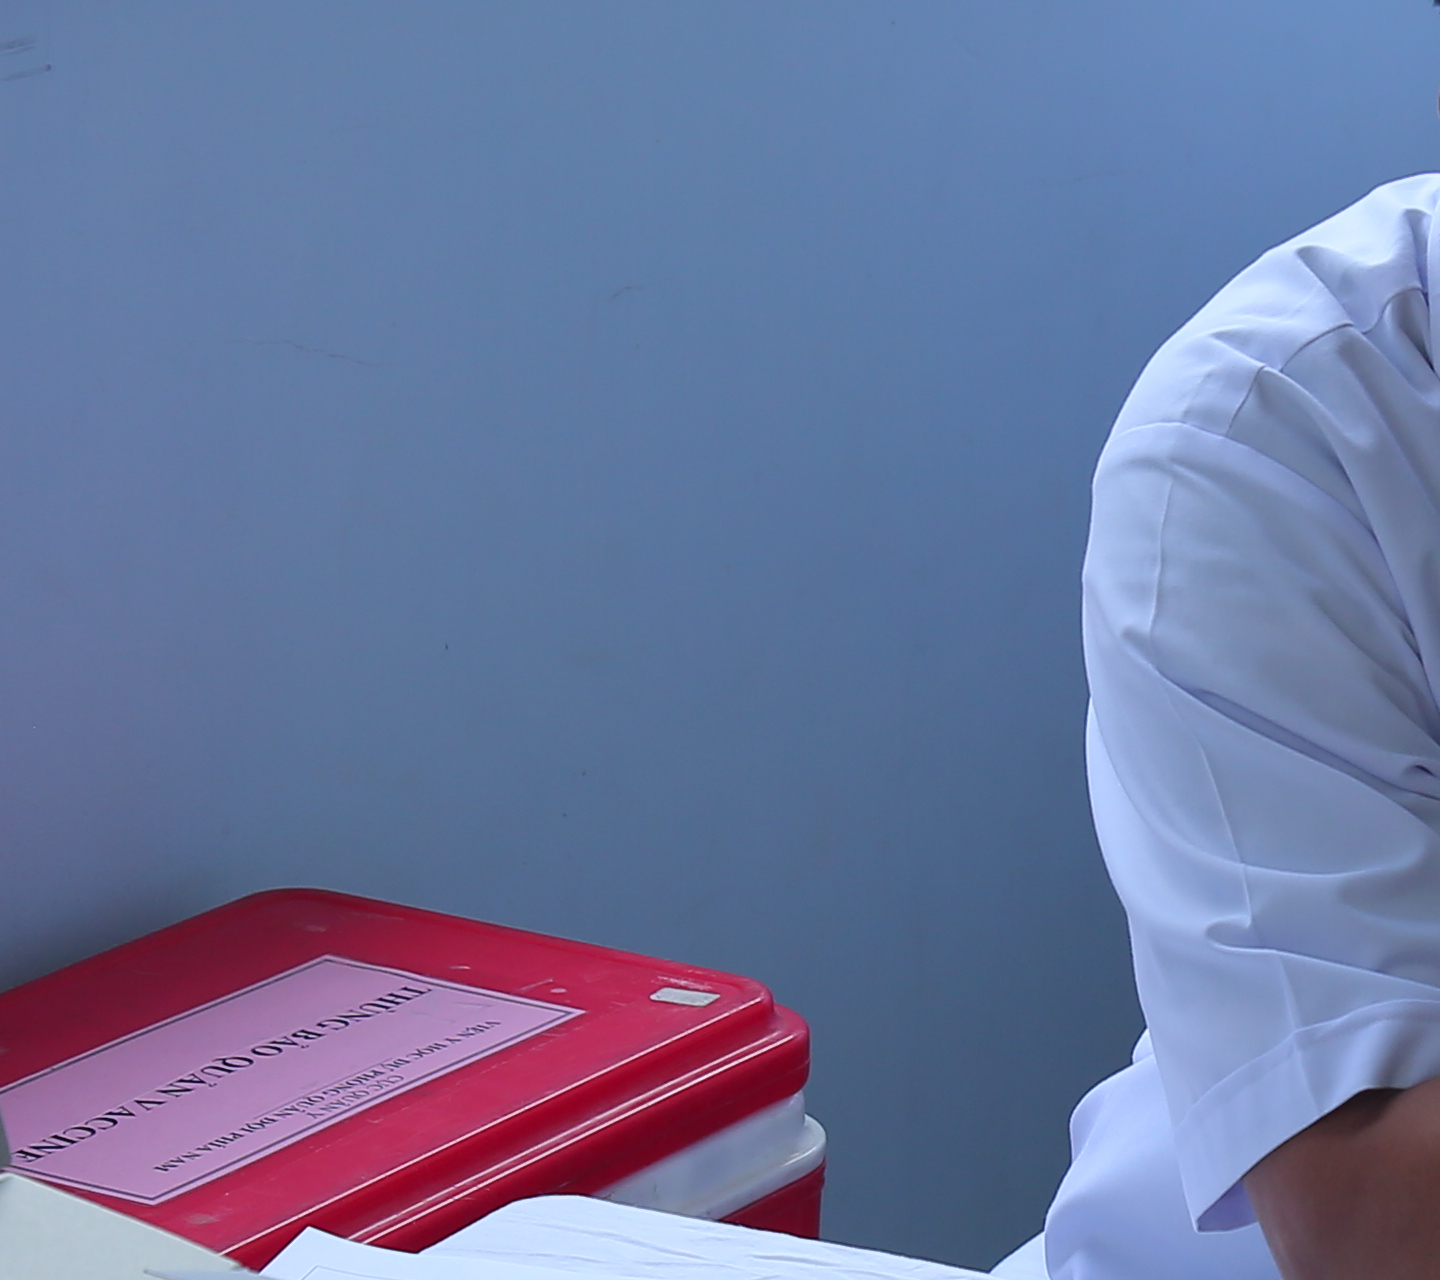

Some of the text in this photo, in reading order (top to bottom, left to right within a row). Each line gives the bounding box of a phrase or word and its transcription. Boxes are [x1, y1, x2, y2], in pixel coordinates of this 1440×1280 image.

[316, 986, 433, 1031] THÙNG
[250, 1028, 326, 1058] BẢO
[155, 1055, 255, 1099] QUẢN
[153, 1150, 202, 1173] NAM
